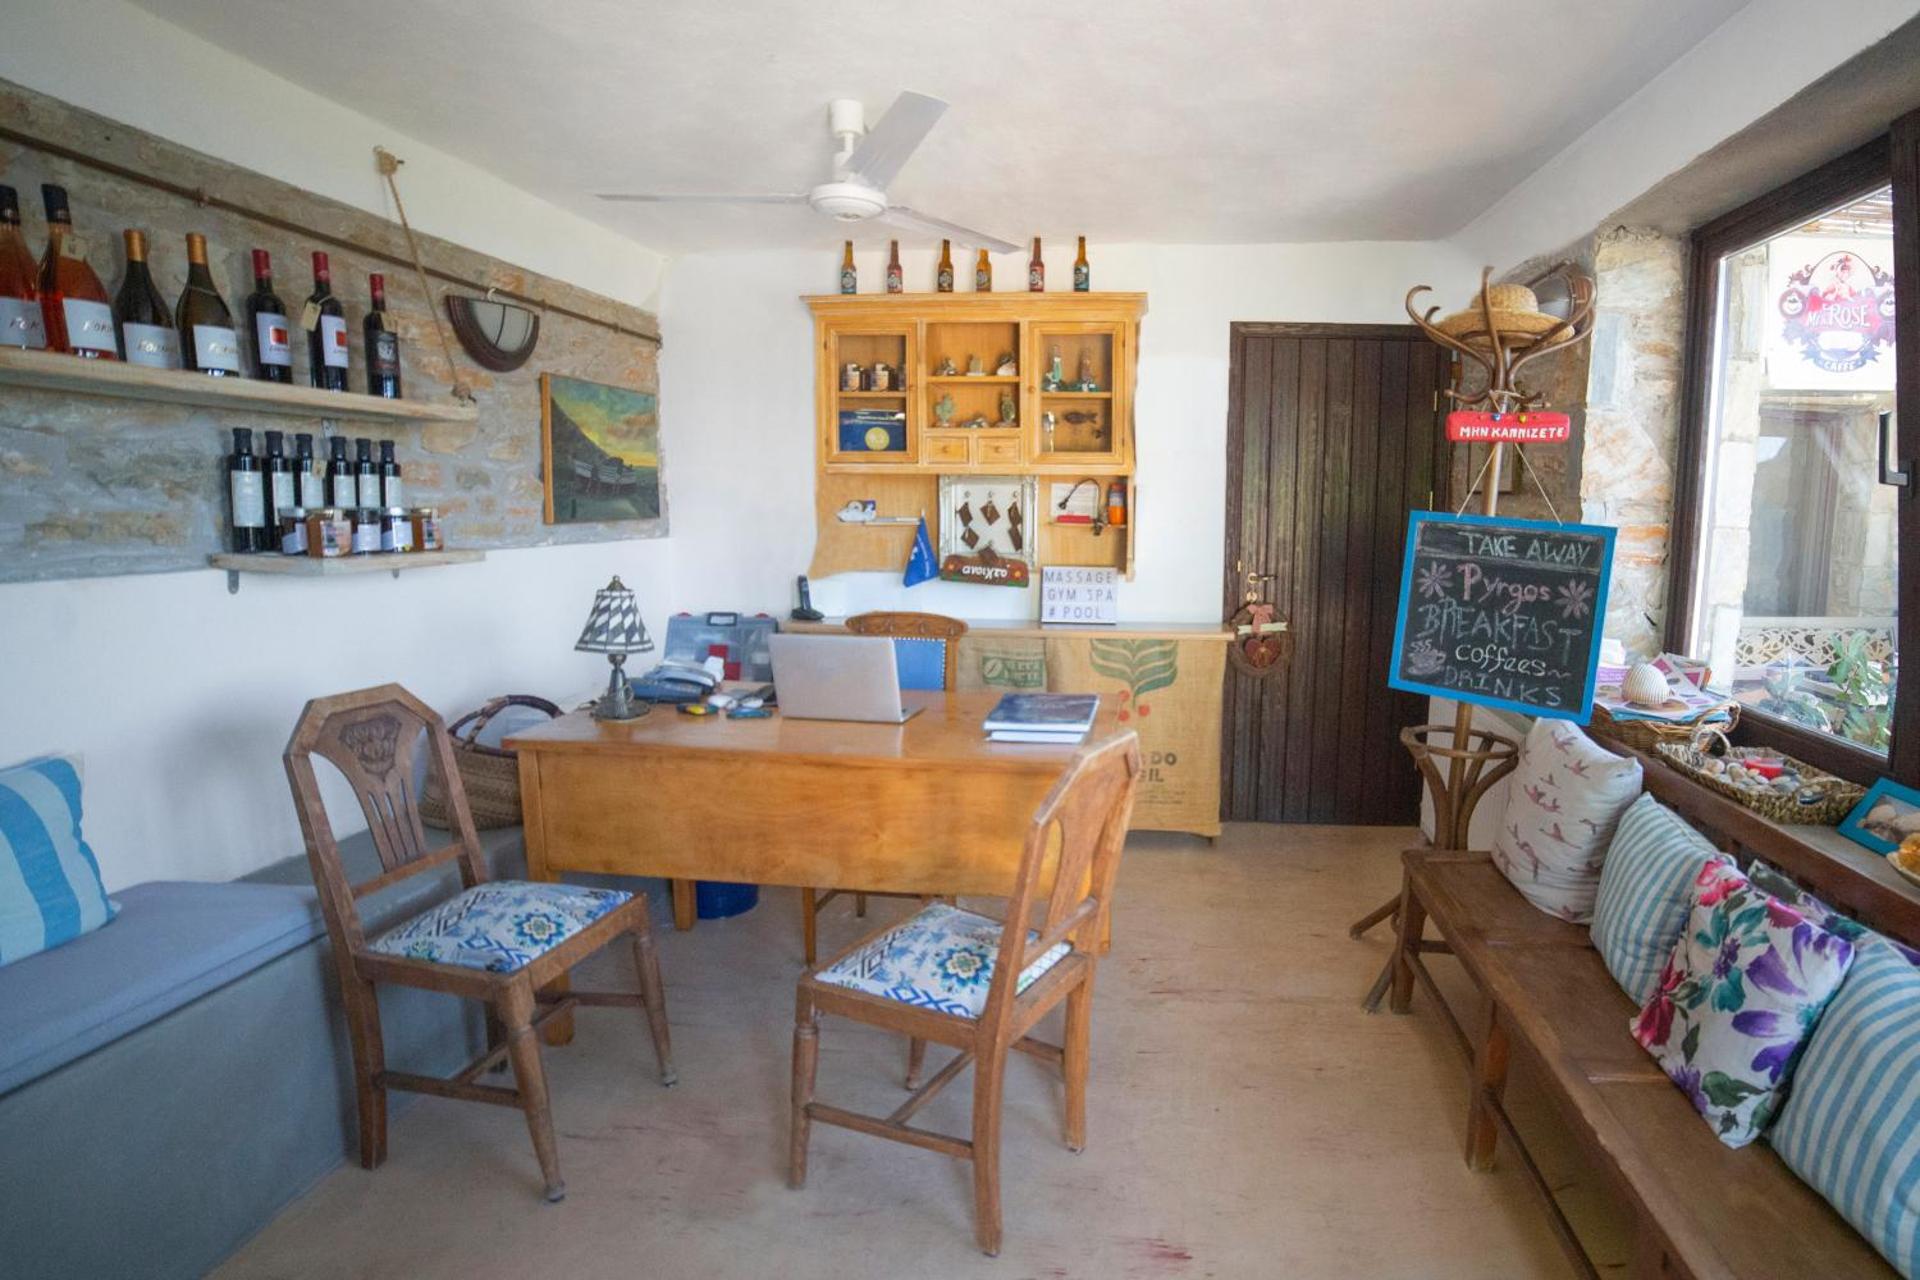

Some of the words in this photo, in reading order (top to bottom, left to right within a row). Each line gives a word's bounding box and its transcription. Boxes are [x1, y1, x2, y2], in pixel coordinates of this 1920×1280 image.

[1827, 303, 1870, 330] ROSE
[1460, 426, 1489, 438] ΜΗΝ
[1457, 531, 1519, 558] TAKE
[1526, 539, 1591, 566] AWAY
[1044, 570, 1113, 584] MASSAGE
[1456, 562, 1551, 615] Pyrgos
[1047, 588, 1076, 601] GYM
[1087, 588, 1113, 601] SPA
[1048, 606, 1056, 617] #
[1063, 606, 1101, 619] POOL
[1416, 596, 1583, 665] BREAKFAST
[1444, 665, 1562, 706] DRINKS
